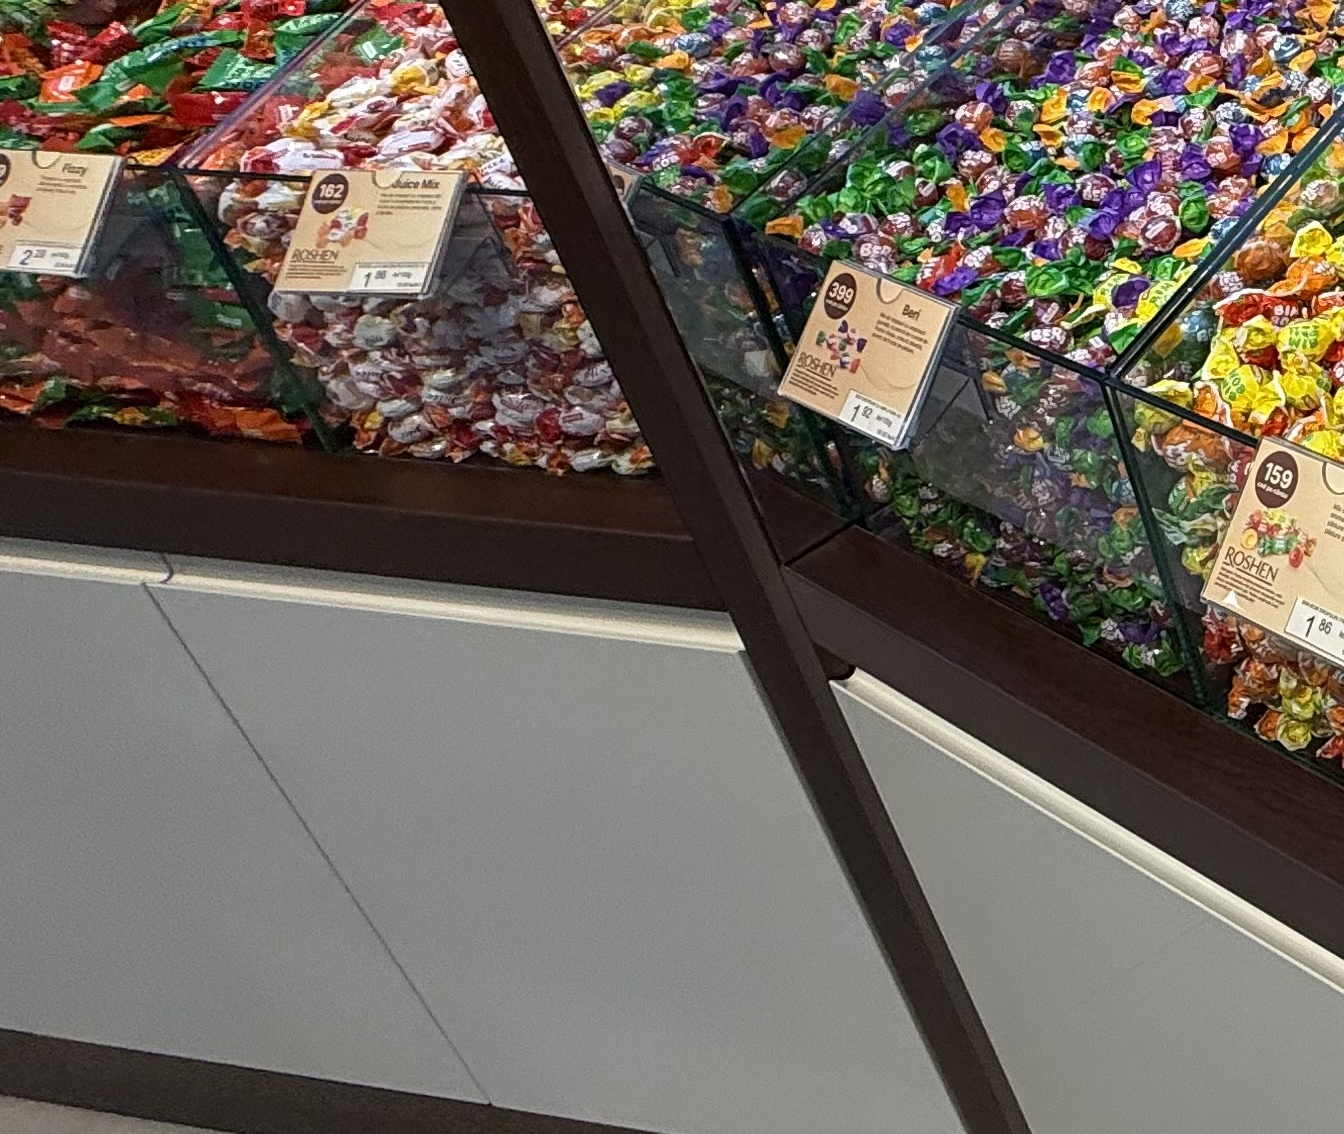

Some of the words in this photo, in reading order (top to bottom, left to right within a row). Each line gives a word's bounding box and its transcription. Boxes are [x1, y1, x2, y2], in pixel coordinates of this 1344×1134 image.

[319, 184, 345, 198] 162
[421, 179, 440, 189] Mix
[19, 249, 33, 266] 2
[291, 250, 339, 261] ROSHEN
[363, 272, 372, 287] 1
[828, 282, 854, 304] 399
[798, 352, 836, 378] ROSHEN
[851, 405, 860, 422] 1
[1264, 462, 1293, 489] 159
[1225, 546, 1279, 582] ROSHEN
[1306, 615, 1316, 637] 1
[1319, 618, 1333, 635] 86
